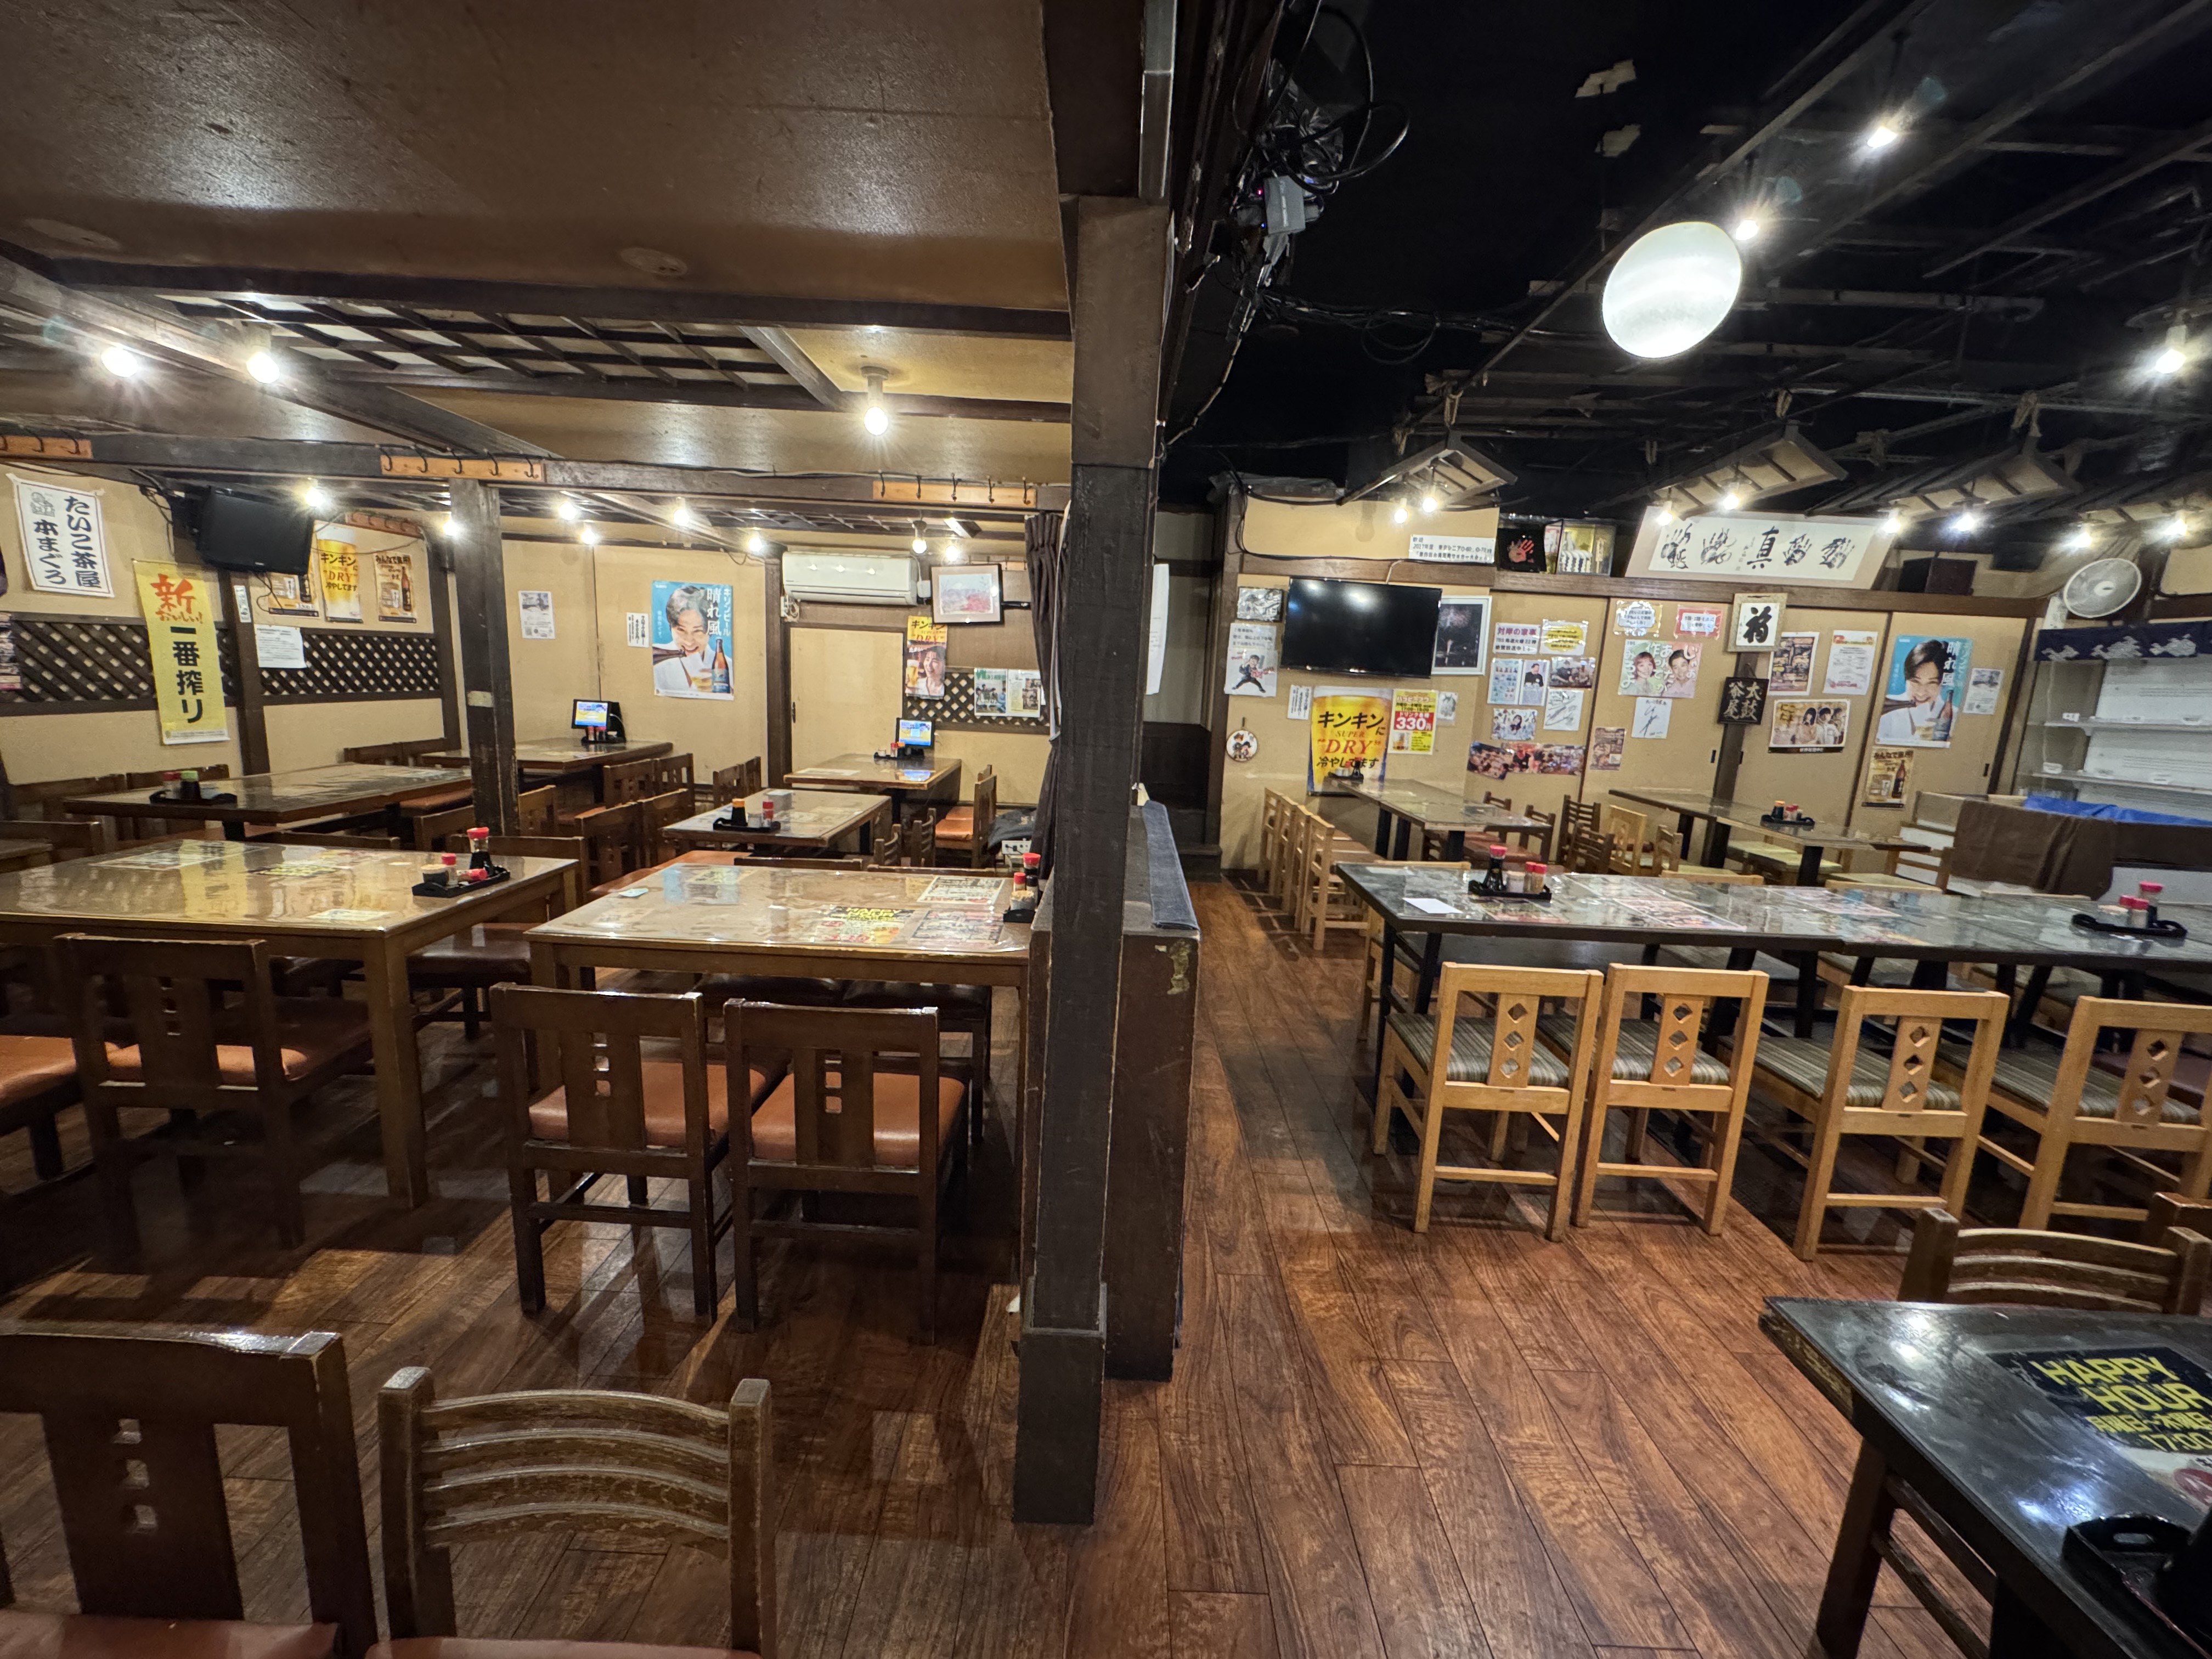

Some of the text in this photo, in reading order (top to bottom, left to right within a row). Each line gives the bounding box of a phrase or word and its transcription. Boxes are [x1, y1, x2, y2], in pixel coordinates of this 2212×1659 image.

[33, 519, 66, 585] 本まぐろ
[64, 495, 102, 589] たいこ茶屋
[321, 552, 356, 566] キンキン
[151, 573, 194, 613] 新
[326, 582, 358, 591] 冷やしてます
[707, 588, 722, 636] 晴れ風
[1743, 606, 1772, 644] 福
[1498, 627, 1537, 635] 対岸の家事
[170, 625, 205, 723] 一番搾り
[1317, 711, 1384, 729] キンキン
[2029, 1356, 2180, 1386] HAPPY
[2080, 1383, 2212, 1413] HOUR
